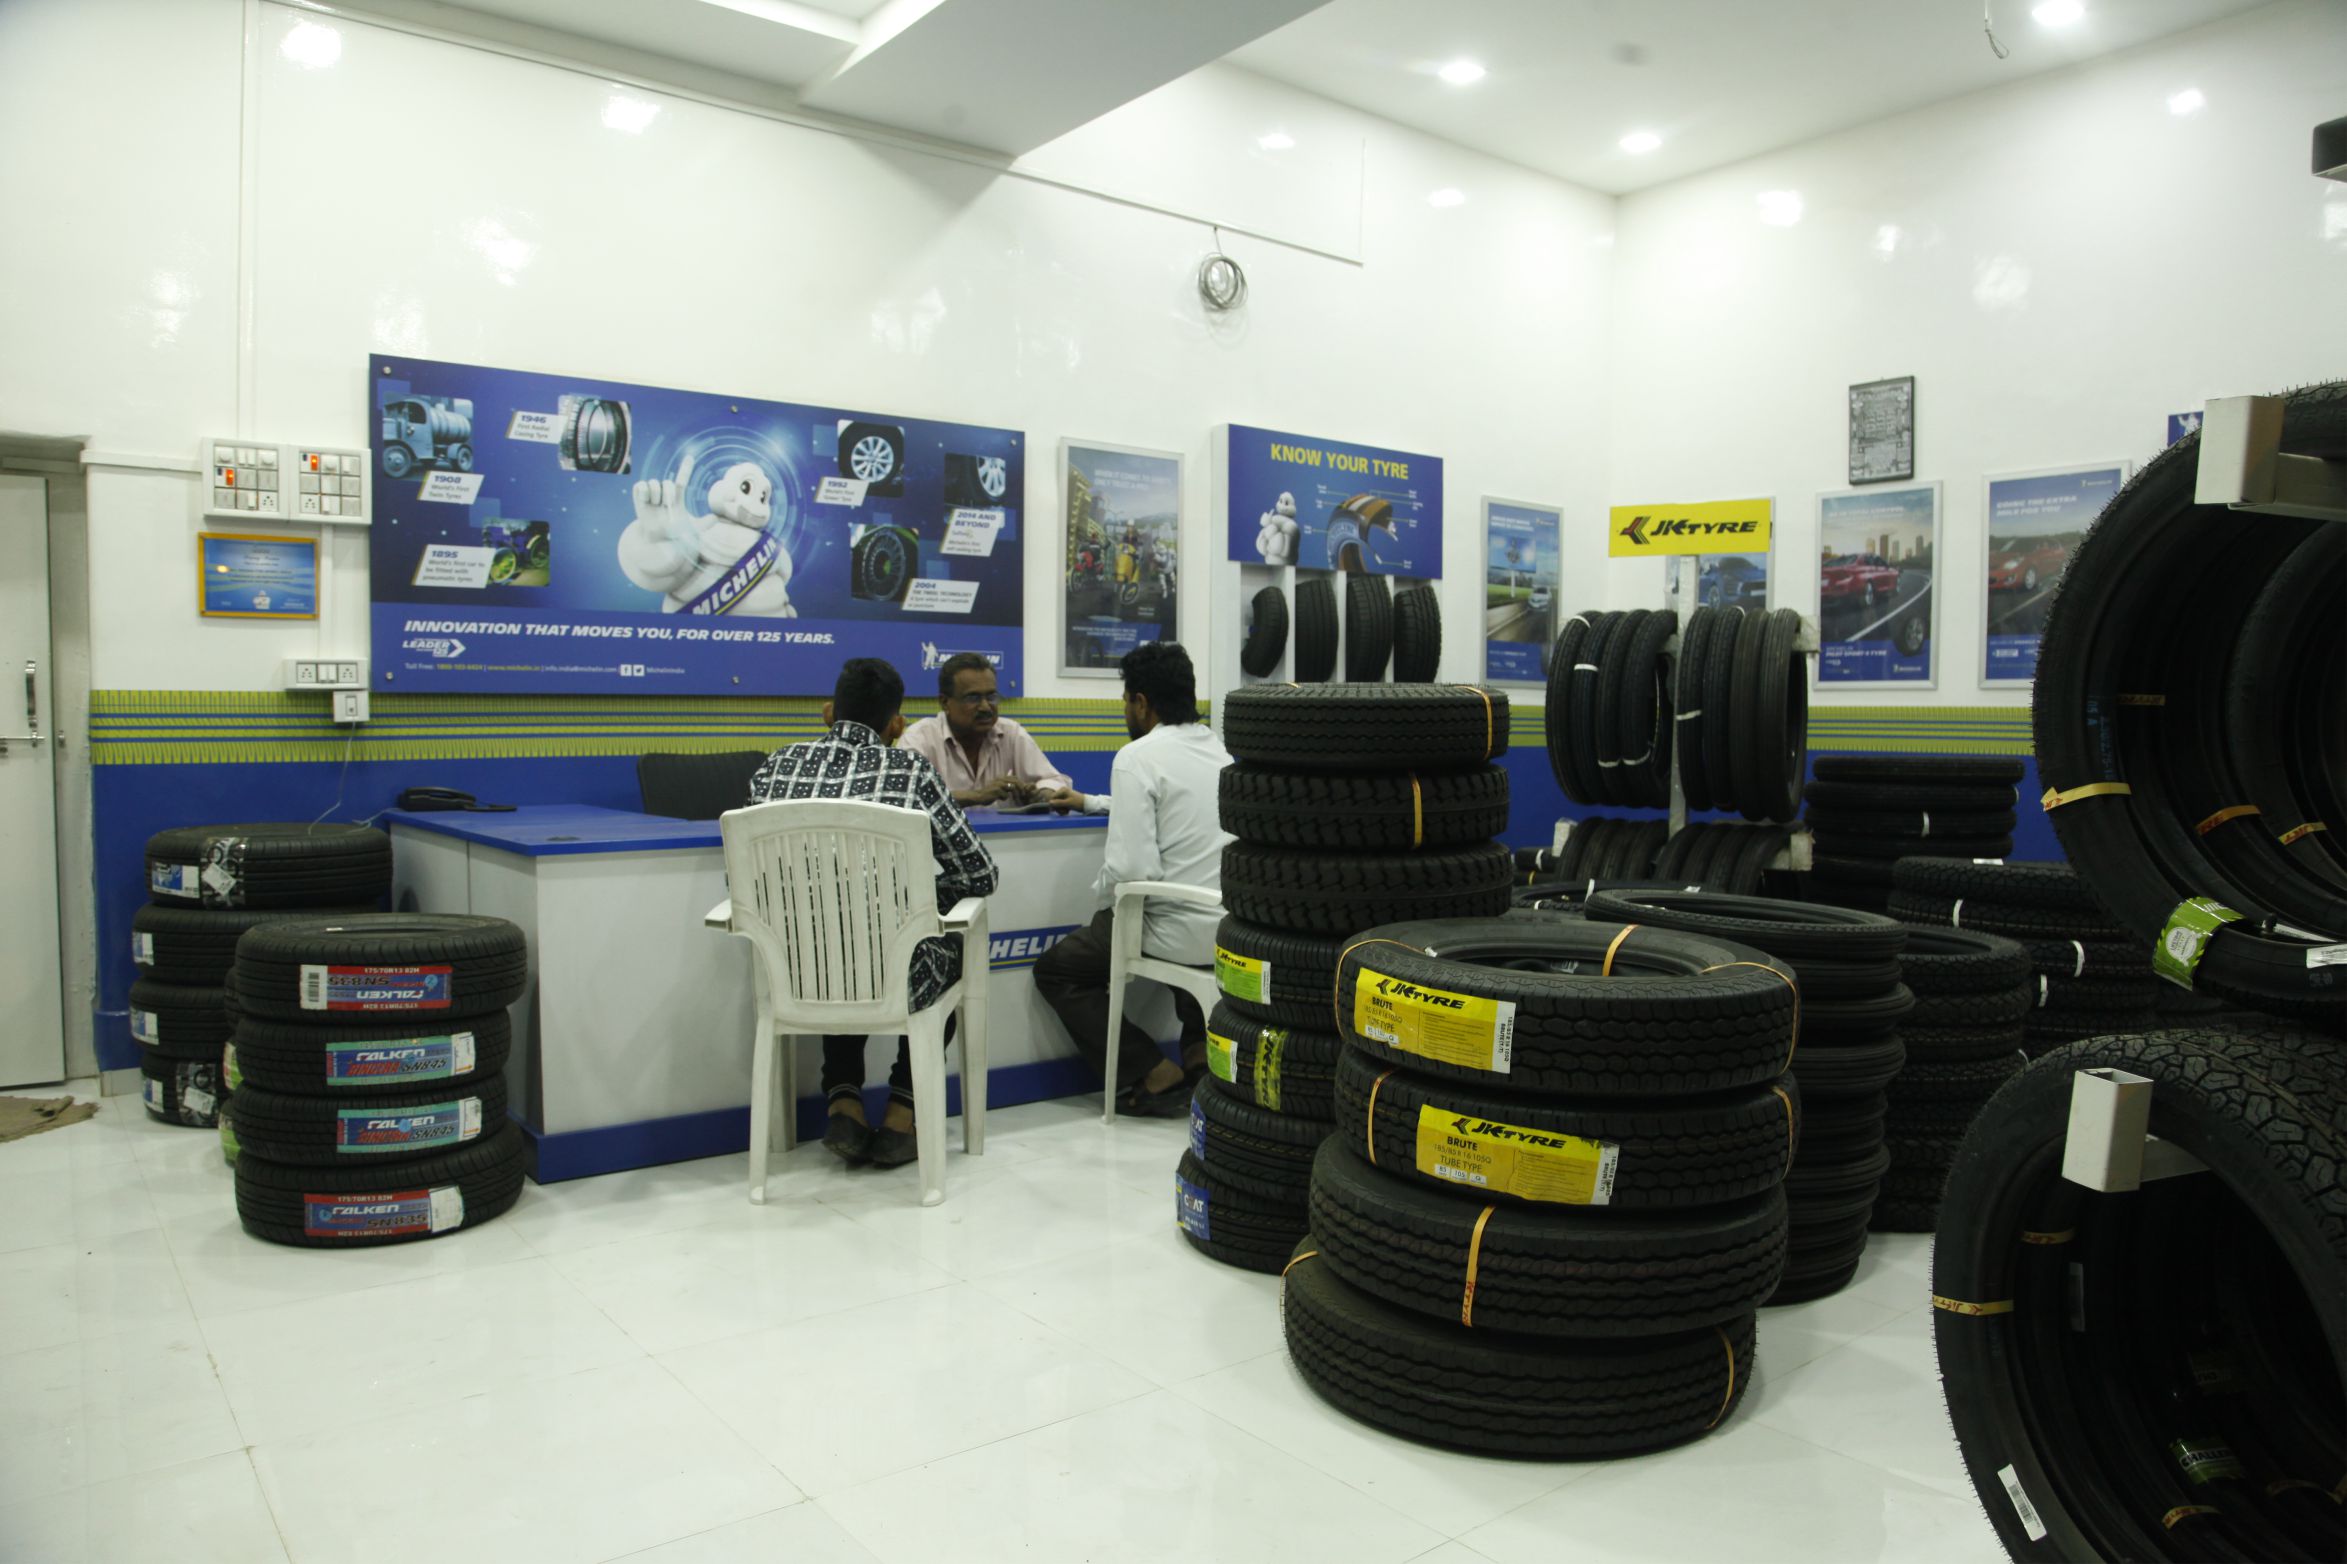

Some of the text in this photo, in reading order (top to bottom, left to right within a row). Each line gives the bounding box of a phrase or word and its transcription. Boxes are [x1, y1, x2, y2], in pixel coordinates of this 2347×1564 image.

[521, 414, 547, 423] 1946
[1271, 443, 1409, 480] KNOW YOUR TYRE
[434, 475, 462, 483] 1908
[954, 520, 991, 529] BEYOND
[432, 550, 459, 559] 1895
[693, 537, 777, 615] MICHELIN
[404, 620, 835, 645] INNOVATION THAT MOVES YOU, FOR OVER 125 YEARS.
[402, 640, 451, 650] LEADER
[989, 934, 1068, 959] HELI
[356, 990, 424, 1000] FALKEN
[1372, 996, 1393, 1011] BRUTE
[1380, 1020, 1395, 1033] TYPE
[356, 1049, 425, 1062] FALKEN
[368, 1116, 435, 1130] FALEN
[1447, 1136, 1478, 1151] BRUTE
[1440, 1156, 1483, 1173] TUBE TYPE
[1462, 1152, 1472, 1160] 16
[1473, 1154, 1492, 1165] 105Q
[332, 1204, 399, 1215] FALKEN
